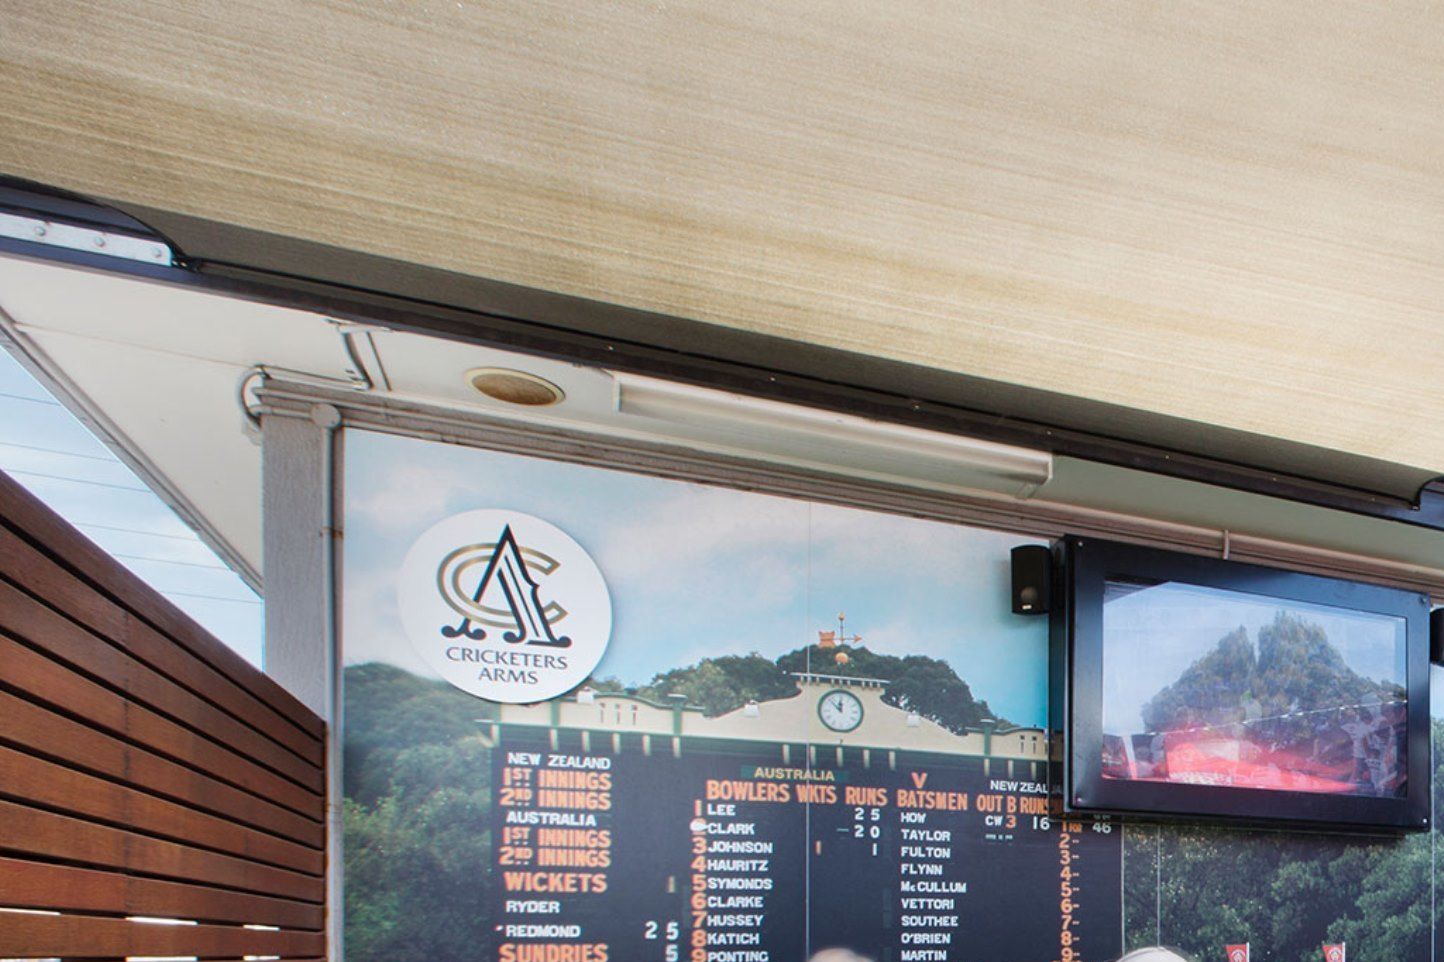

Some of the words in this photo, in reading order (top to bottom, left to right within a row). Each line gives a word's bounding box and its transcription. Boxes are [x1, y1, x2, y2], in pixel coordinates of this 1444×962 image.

[446, 646, 568, 670] CRICKETERS
[478, 666, 538, 684] ARMS
[507, 752, 541, 766] NEW
[548, 754, 612, 770] ZEALAND
[538, 769, 613, 791] INNINGS
[754, 767, 835, 782] AUSTRALIA
[911, 772, 928, 789] V
[990, 779, 1018, 791] NEW
[1019, 781, 1048, 793] ZEAL
[538, 789, 612, 811] INNINGS
[706, 780, 790, 803] BOWLERS
[796, 784, 838, 804] WKTS
[845, 786, 888, 806] RUNS
[897, 788, 968, 811] BATSMEN
[976, 794, 1003, 813] OUT
[1007, 795, 1017, 813] B
[707, 804, 736, 816] LEE
[506, 810, 597, 827] AUSTRALIA
[901, 812, 926, 823] HOW
[1006, 815, 1017, 829] 3
[707, 823, 755, 836] CLARK
[1092, 822, 1112, 834] 46
[537, 828, 612, 849] INNINGS
[901, 829, 951, 842] TAYLOR
[708, 841, 773, 854] JOHNSON
[901, 846, 951, 859] FULTON
[537, 848, 612, 869] INNINGS
[707, 859, 769, 872] HAURITZ
[901, 864, 943, 876] FLYNN
[504, 872, 608, 893] WICKETS
[707, 878, 773, 890] SYMONDS
[506, 901, 560, 913] RYDER
[707, 896, 764, 908] CLARKE
[901, 898, 954, 910] VETTORI
[707, 915, 764, 927] HUSSEY
[901, 915, 959, 927] SOUTHEE
[506, 925, 581, 938] REDMOND
[901, 932, 951, 944] O'BRIEN
[707, 933, 760, 945] KATICH
[665, 945, 679, 962] 5
[707, 951, 769, 962] PONTING
[901, 950, 947, 961] MARTIN
